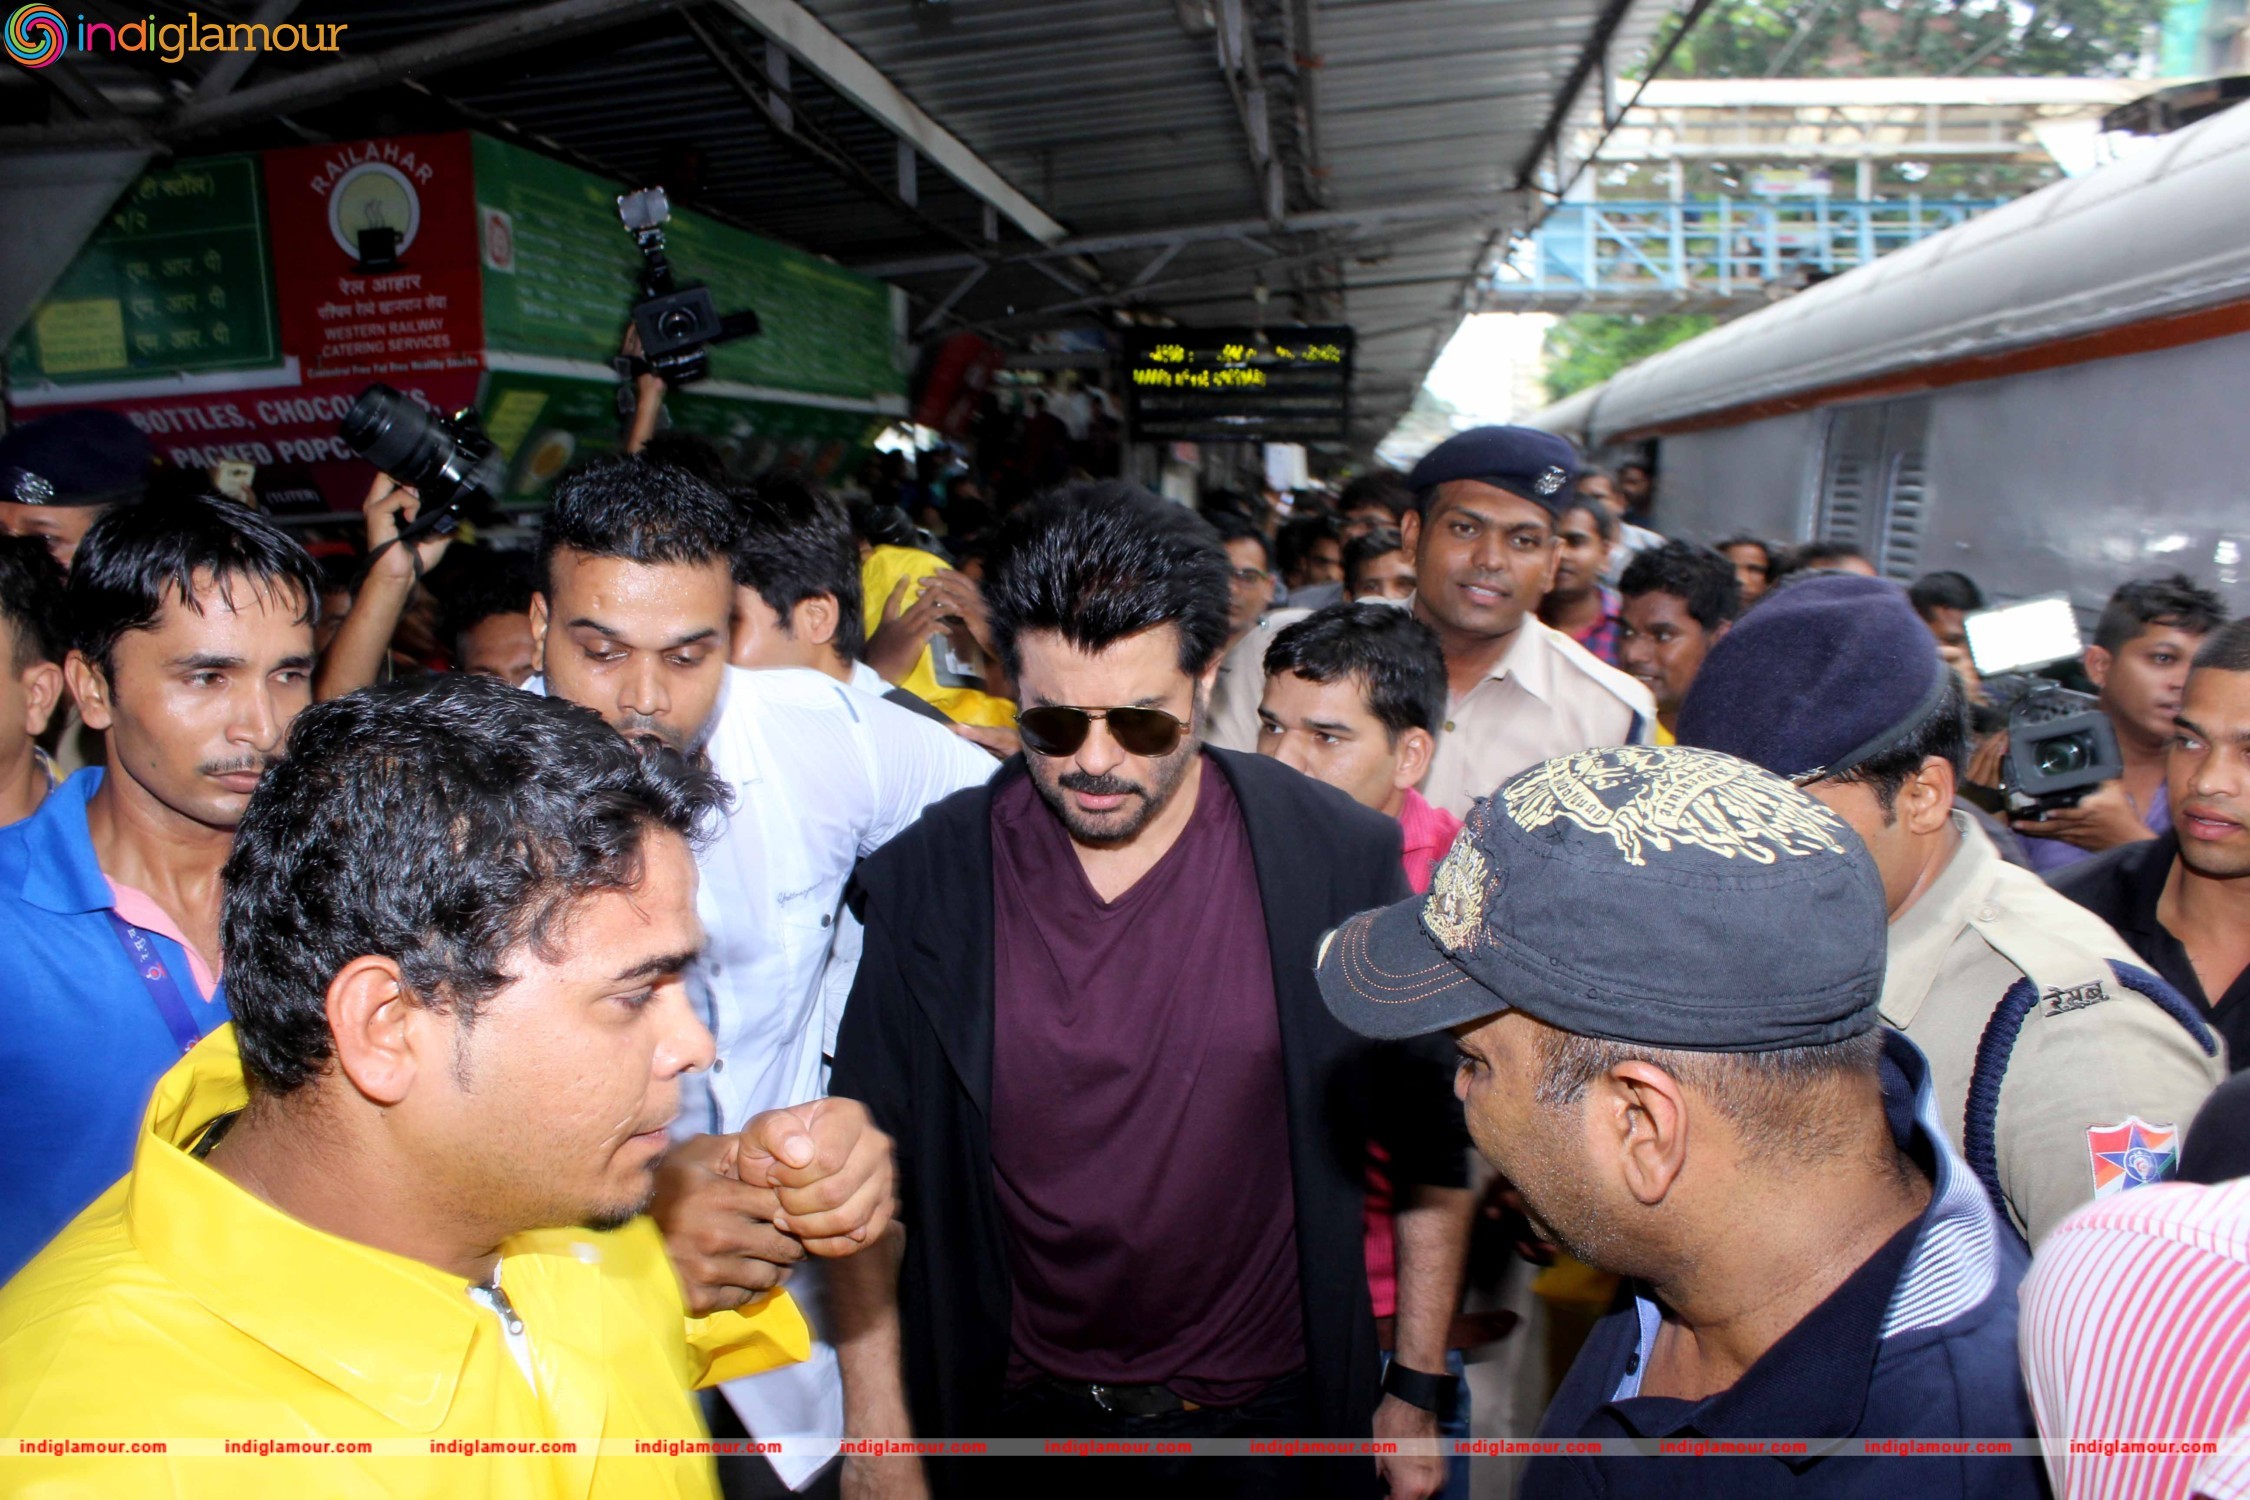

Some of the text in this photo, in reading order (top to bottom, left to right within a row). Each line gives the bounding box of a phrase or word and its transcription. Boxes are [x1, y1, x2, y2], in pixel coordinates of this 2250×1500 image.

[310, 142, 434, 195] RAILAHAR
[372, 274, 421, 293] आहार
[324, 317, 444, 341] WESTERN RAILWAY
[321, 334, 451, 359] CATERING SERVICES
[127, 404, 256, 434] BOTTLES,
